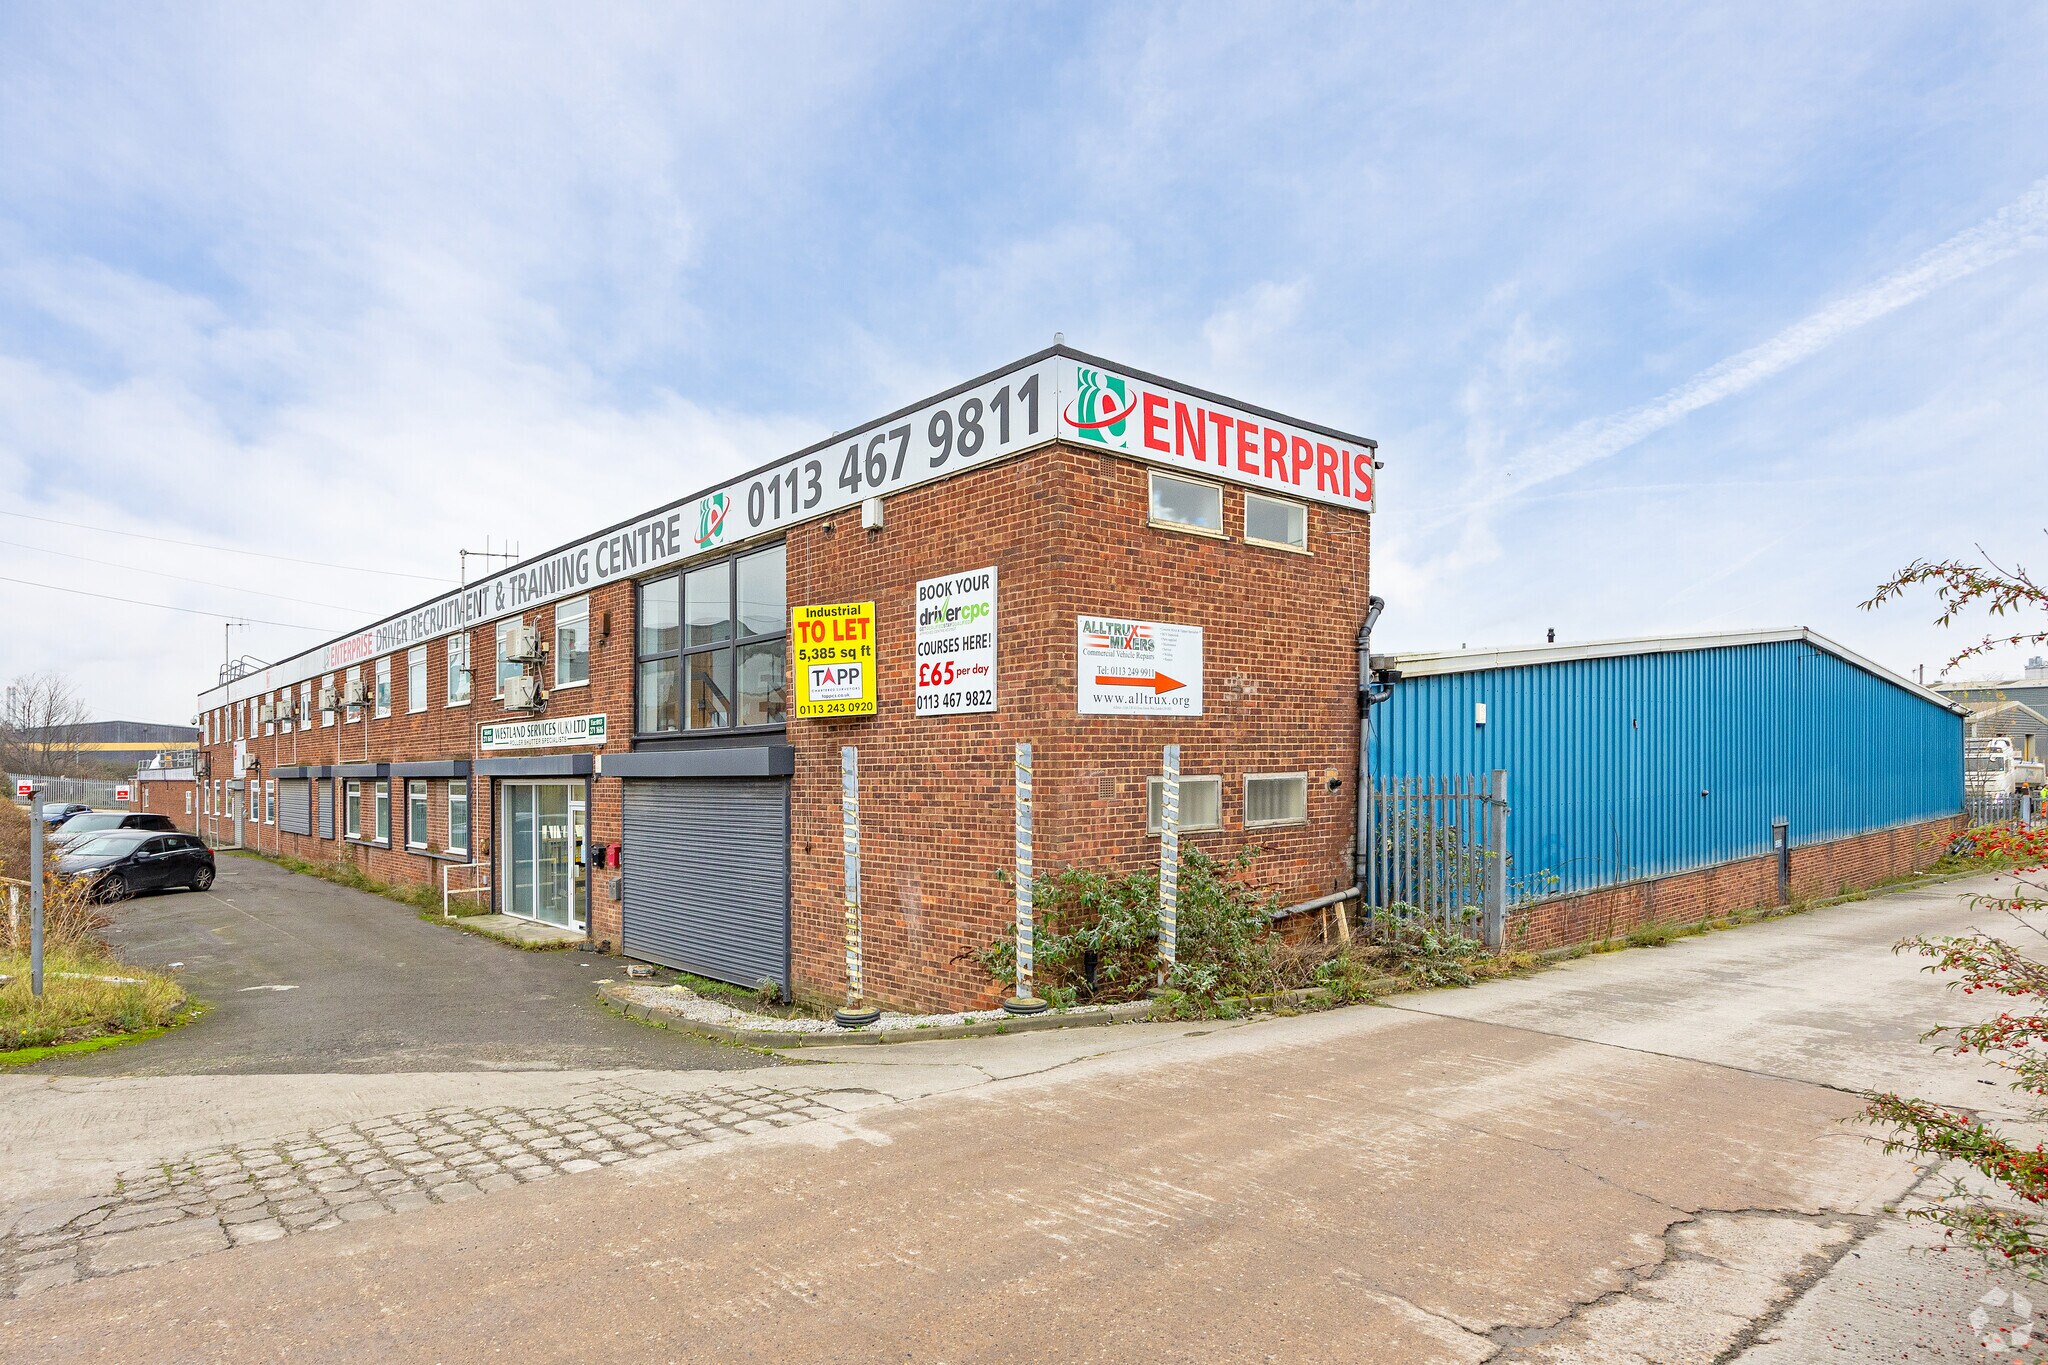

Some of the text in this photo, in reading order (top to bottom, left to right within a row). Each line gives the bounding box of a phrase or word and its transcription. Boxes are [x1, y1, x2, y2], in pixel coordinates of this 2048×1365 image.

[747, 373, 1039, 528] 0113 467 9811
[1142, 391, 1373, 502] ENTERPRIS
[330, 513, 681, 667] ENTERPRISE DRIVER RECRUITMENT & TRAINING CENTRE
[919, 574, 990, 602] BOOK YOUR
[806, 605, 861, 618] Industrial
[798, 618, 870, 643] TO LET
[1082, 620, 1140, 637] ALLTRUX
[918, 633, 992, 656] COURSES HERE!
[1110, 635, 1155, 651] MIXERS
[799, 645, 871, 662] 5,385 sq ft
[1082, 648, 1115, 658] Commercial
[1116, 651, 1135, 659] Vehicle
[1136, 652, 1155, 661] Repairs
[811, 667, 860, 687] TAPP
[919, 660, 989, 687] £65 per day
[1097, 665, 1109, 675] Tel:
[1110, 666, 1126, 676] 0113
[1127, 667, 1139, 676] 249
[800, 702, 873, 715] 0113 243 0920
[917, 689, 992, 710] 0113 467 9822
[1093, 692, 1190, 709] www.alltrux.org
[495, 725, 526, 740] WESTLAND
[527, 722, 556, 737] SERVICES
[573, 719, 587, 734] LTD
